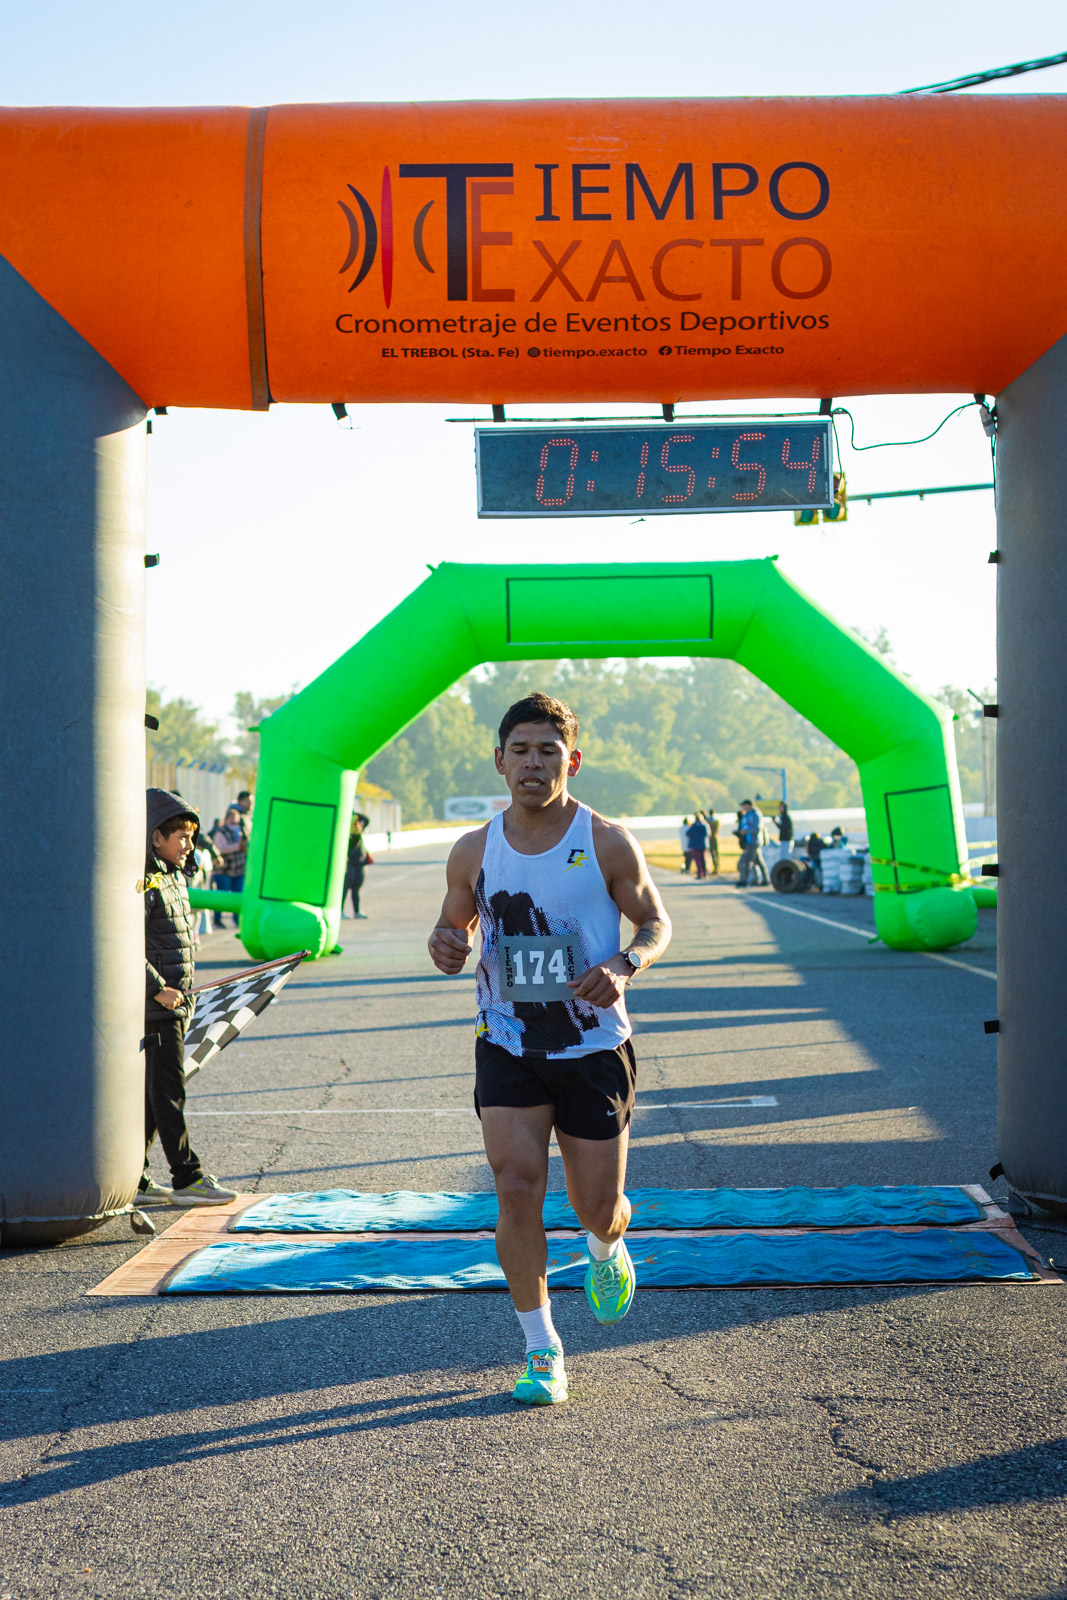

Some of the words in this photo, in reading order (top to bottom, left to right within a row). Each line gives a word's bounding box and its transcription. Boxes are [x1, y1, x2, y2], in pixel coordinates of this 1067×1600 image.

[335, 313, 517, 338] Cronometraje
[524, 312, 557, 332] de
[566, 313, 671, 332] Eventos
[680, 311, 830, 335] Deportivos
[381, 348, 398, 358] EL
[401, 348, 459, 358] TREBOL
[462, 347, 494, 359] (Sta.
[498, 347, 520, 359] Fe)
[543, 346, 647, 359] tiempo.exacto
[674, 345, 731, 357] Tiempo
[735, 344, 784, 355] Exacto
[536, 432, 821, 506] 0:15:54
[504, 946, 513, 988] TIEMPO
[513, 949, 567, 985] 174
[566, 945, 576, 981] EXACT
